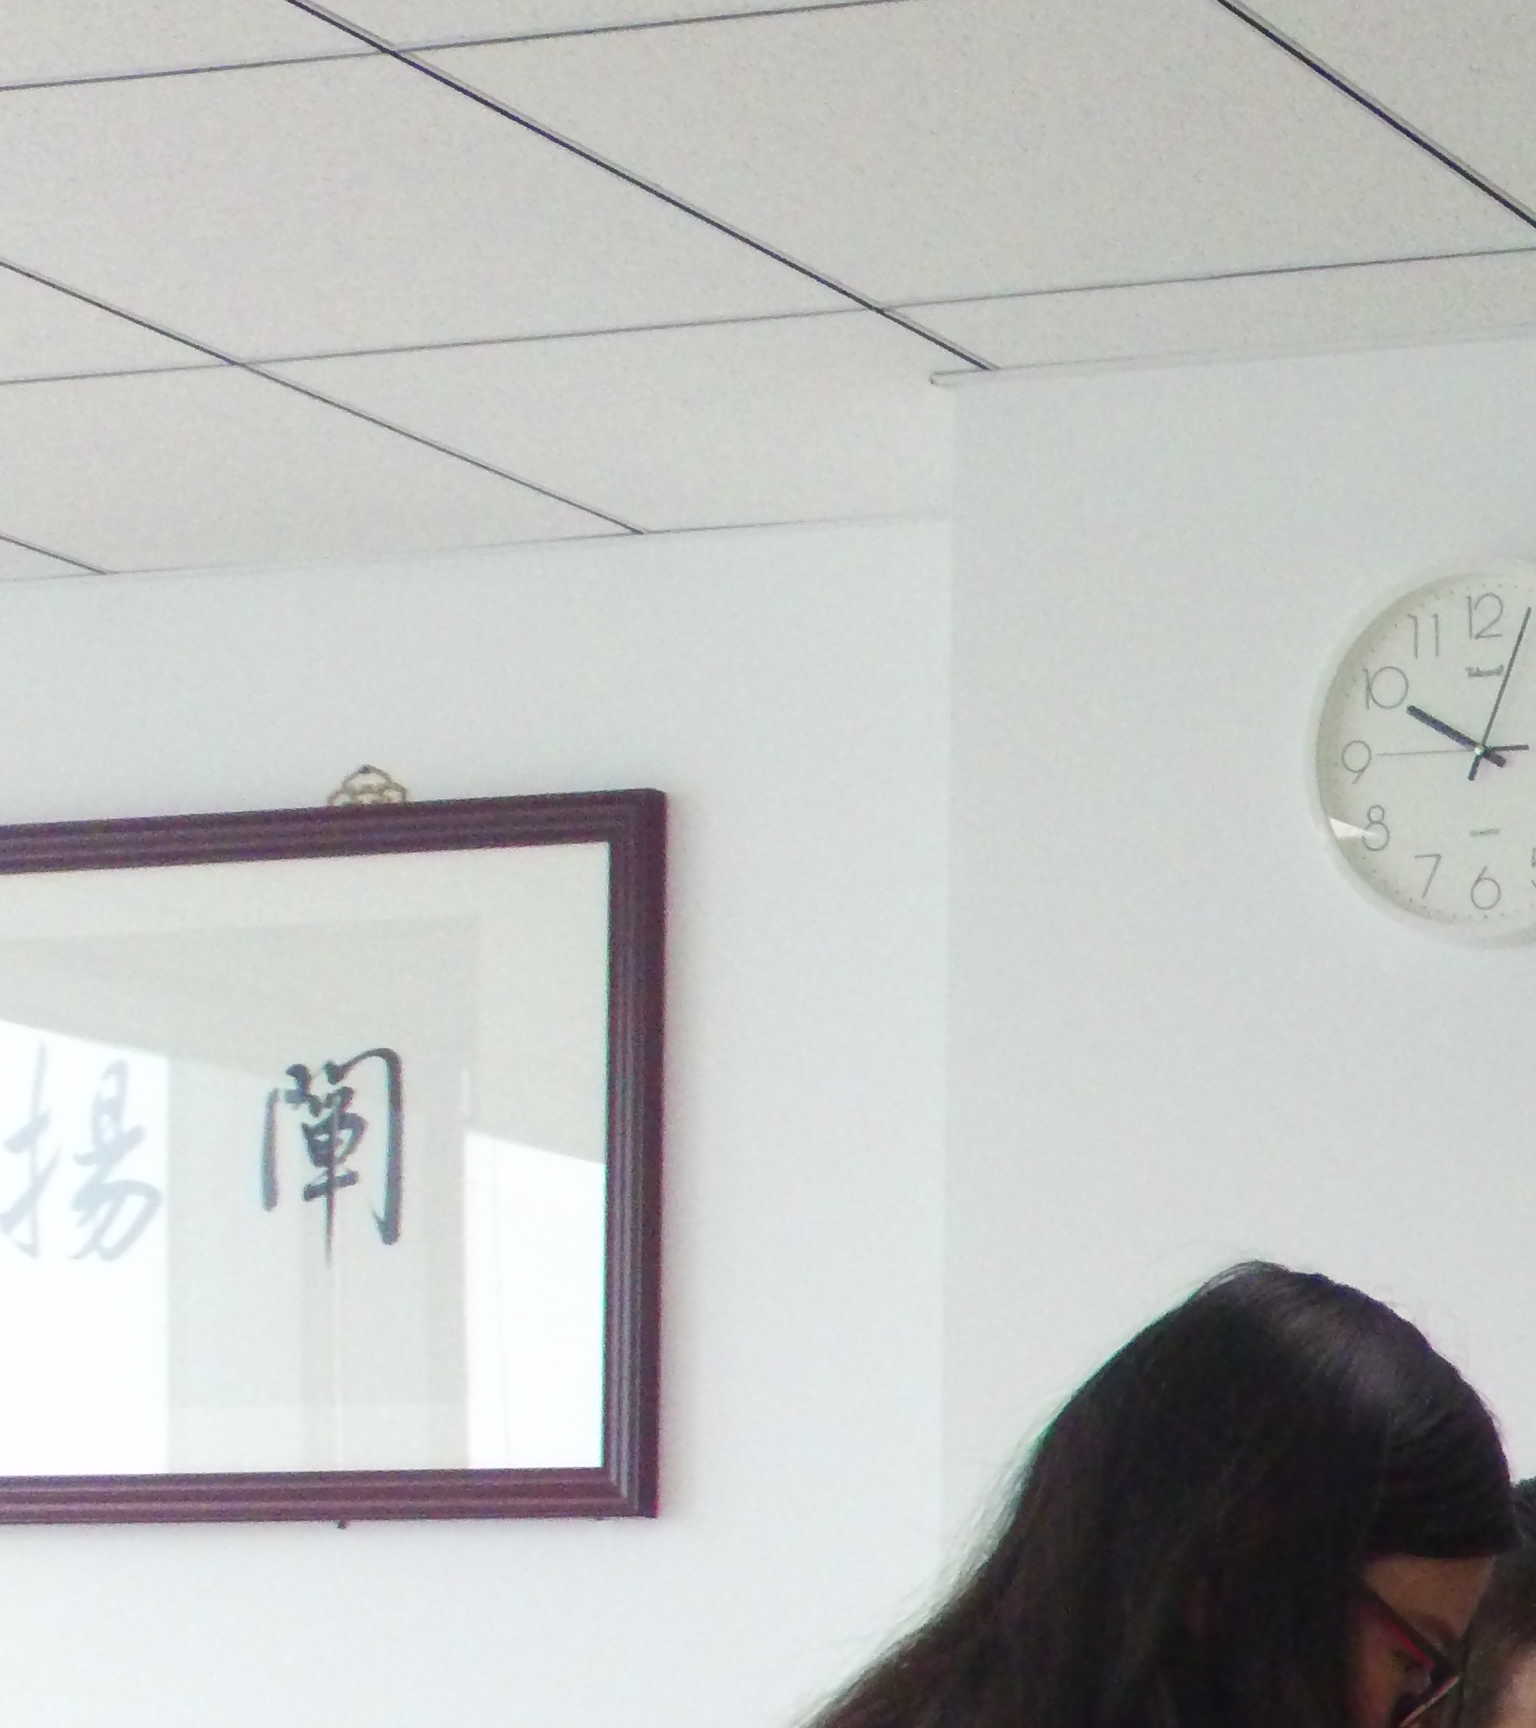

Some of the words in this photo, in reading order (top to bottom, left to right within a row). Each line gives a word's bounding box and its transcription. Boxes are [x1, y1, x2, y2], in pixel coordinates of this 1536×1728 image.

[1408, 612, 1440, 660] 11
[1466, 592, 1503, 640] 12
[1362, 665, 1410, 711] 10
[1341, 739, 1373, 785] 9
[1361, 804, 1391, 852] 8
[1414, 853, 1442, 899] 7
[1470, 865, 1502, 911] 6
